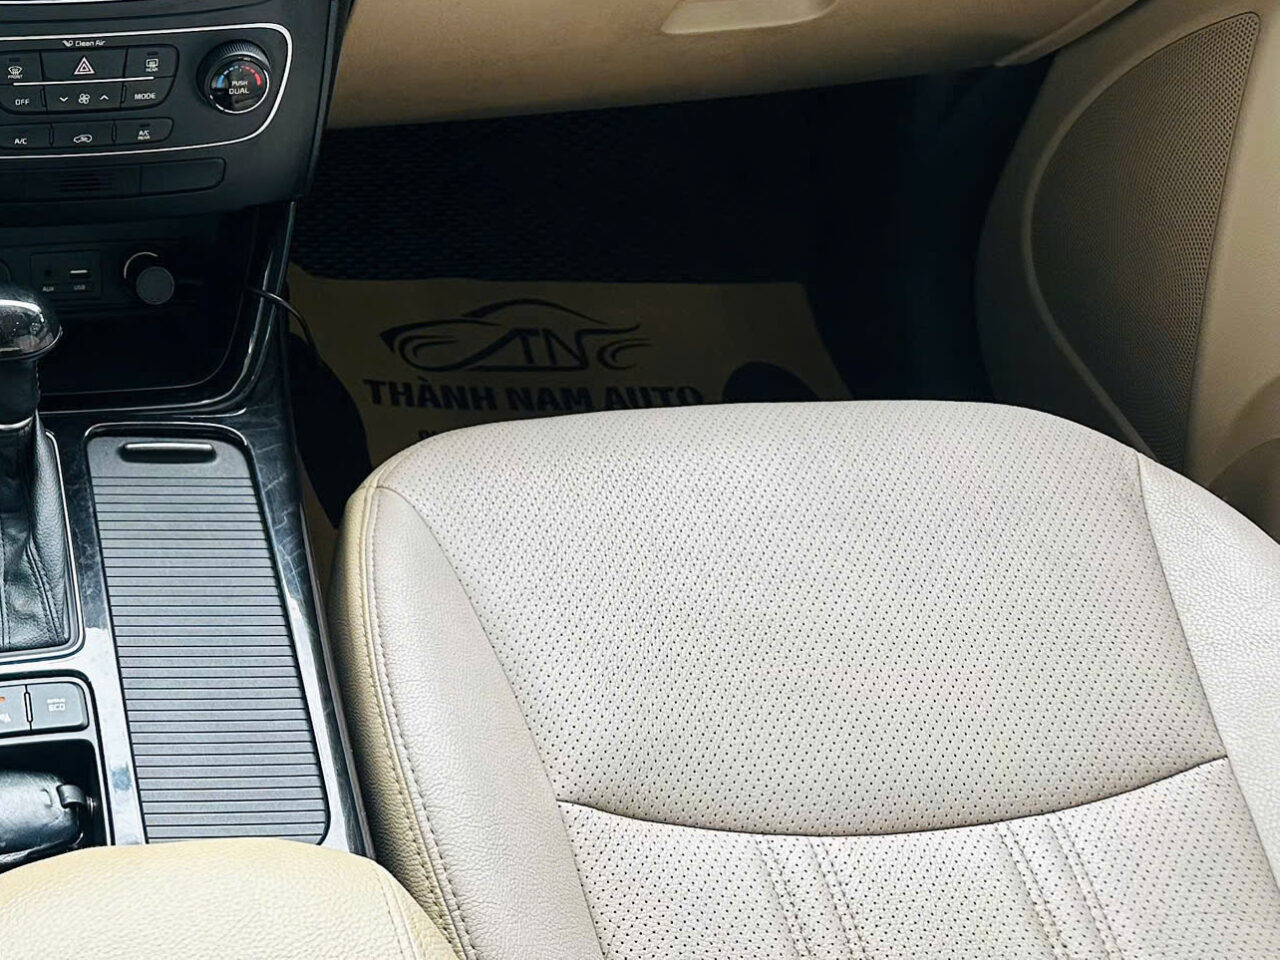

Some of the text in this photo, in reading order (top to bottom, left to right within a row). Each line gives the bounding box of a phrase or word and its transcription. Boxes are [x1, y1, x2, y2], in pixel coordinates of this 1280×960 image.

[228, 87, 250, 95] DUAL
[134, 92, 156, 100] MODE
[15, 98, 30, 106] OFF
[363, 376, 704, 412] THÀNH NAM AUTO
